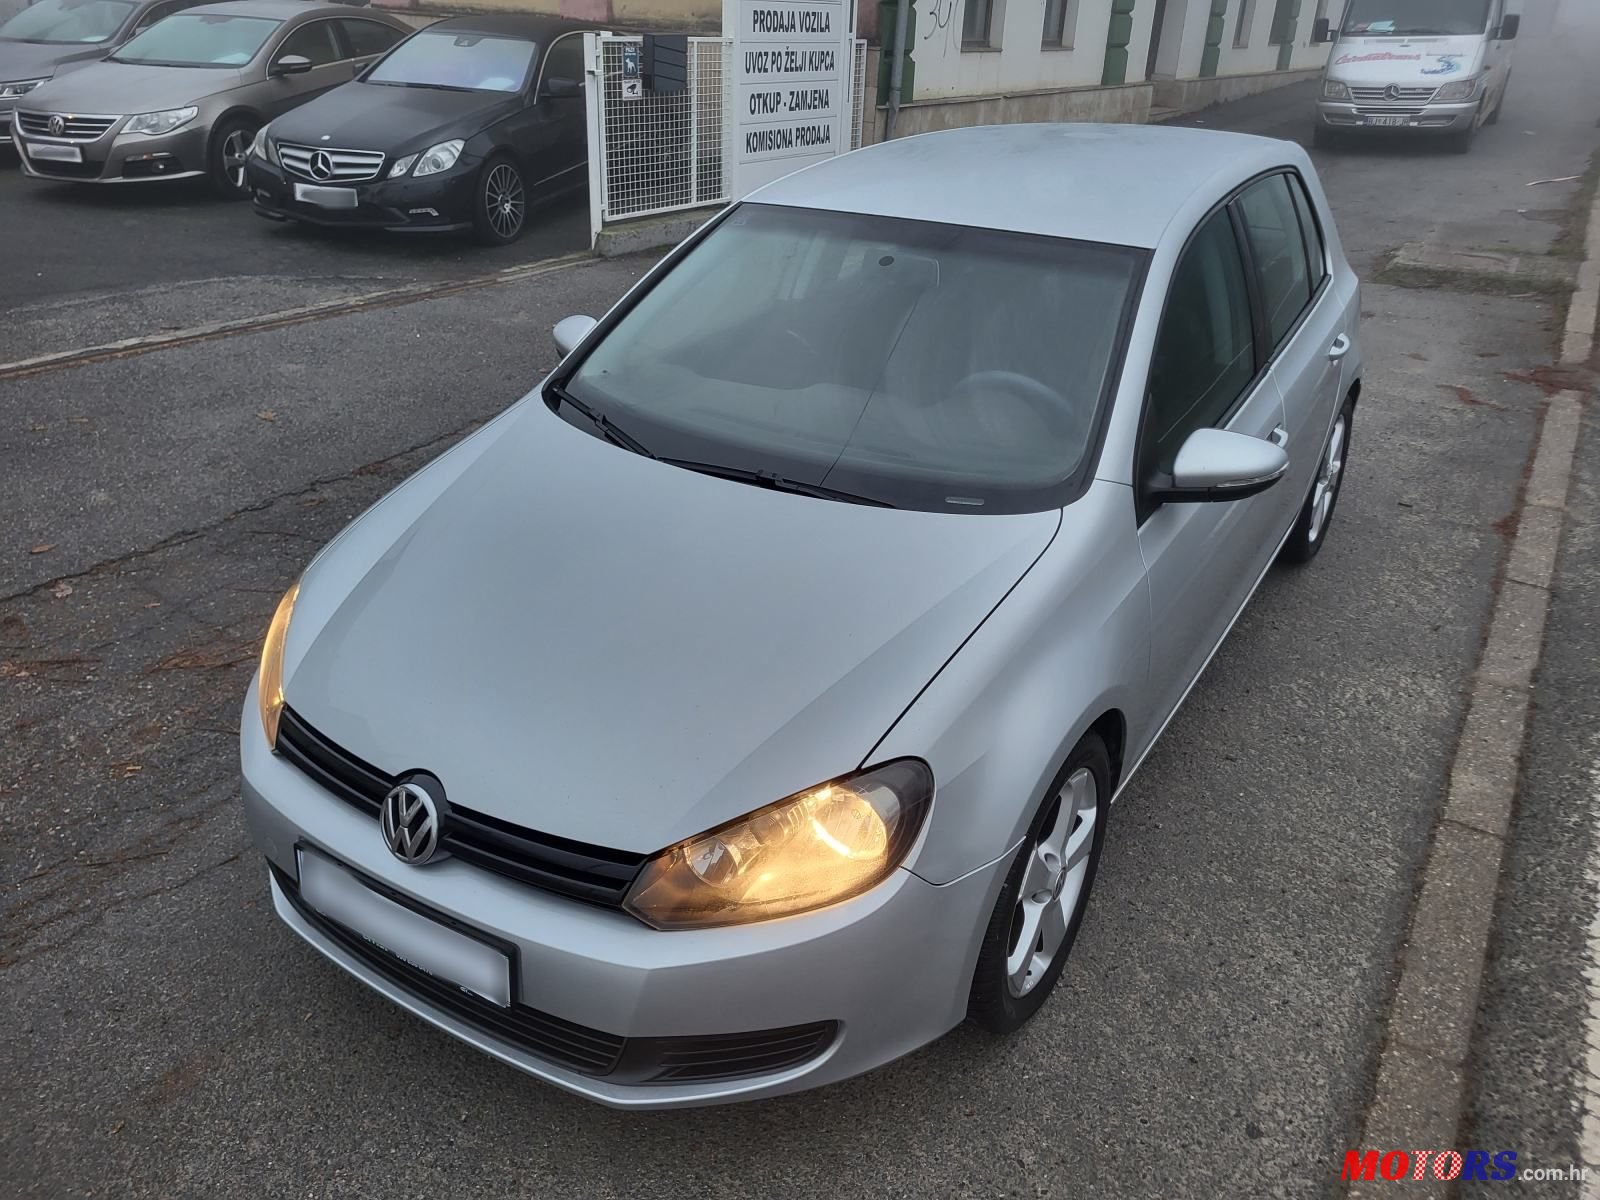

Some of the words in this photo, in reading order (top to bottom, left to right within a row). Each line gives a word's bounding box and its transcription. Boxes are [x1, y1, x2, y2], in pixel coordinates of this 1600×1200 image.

[752, 10, 796, 33] PRODAJA
[799, 12, 831, 33] VOZILA
[745, 51, 769, 74] UVOZ
[770, 51, 783, 73] PO
[784, 45, 807, 73] ŽELJI
[808, 50, 835, 72] KUPCA
[750, 91, 781, 115] OTKUP
[788, 89, 830, 112] ZAMJENA
[746, 128, 793, 154] KOMISIONA
[795, 124, 831, 147] PRODAJA
